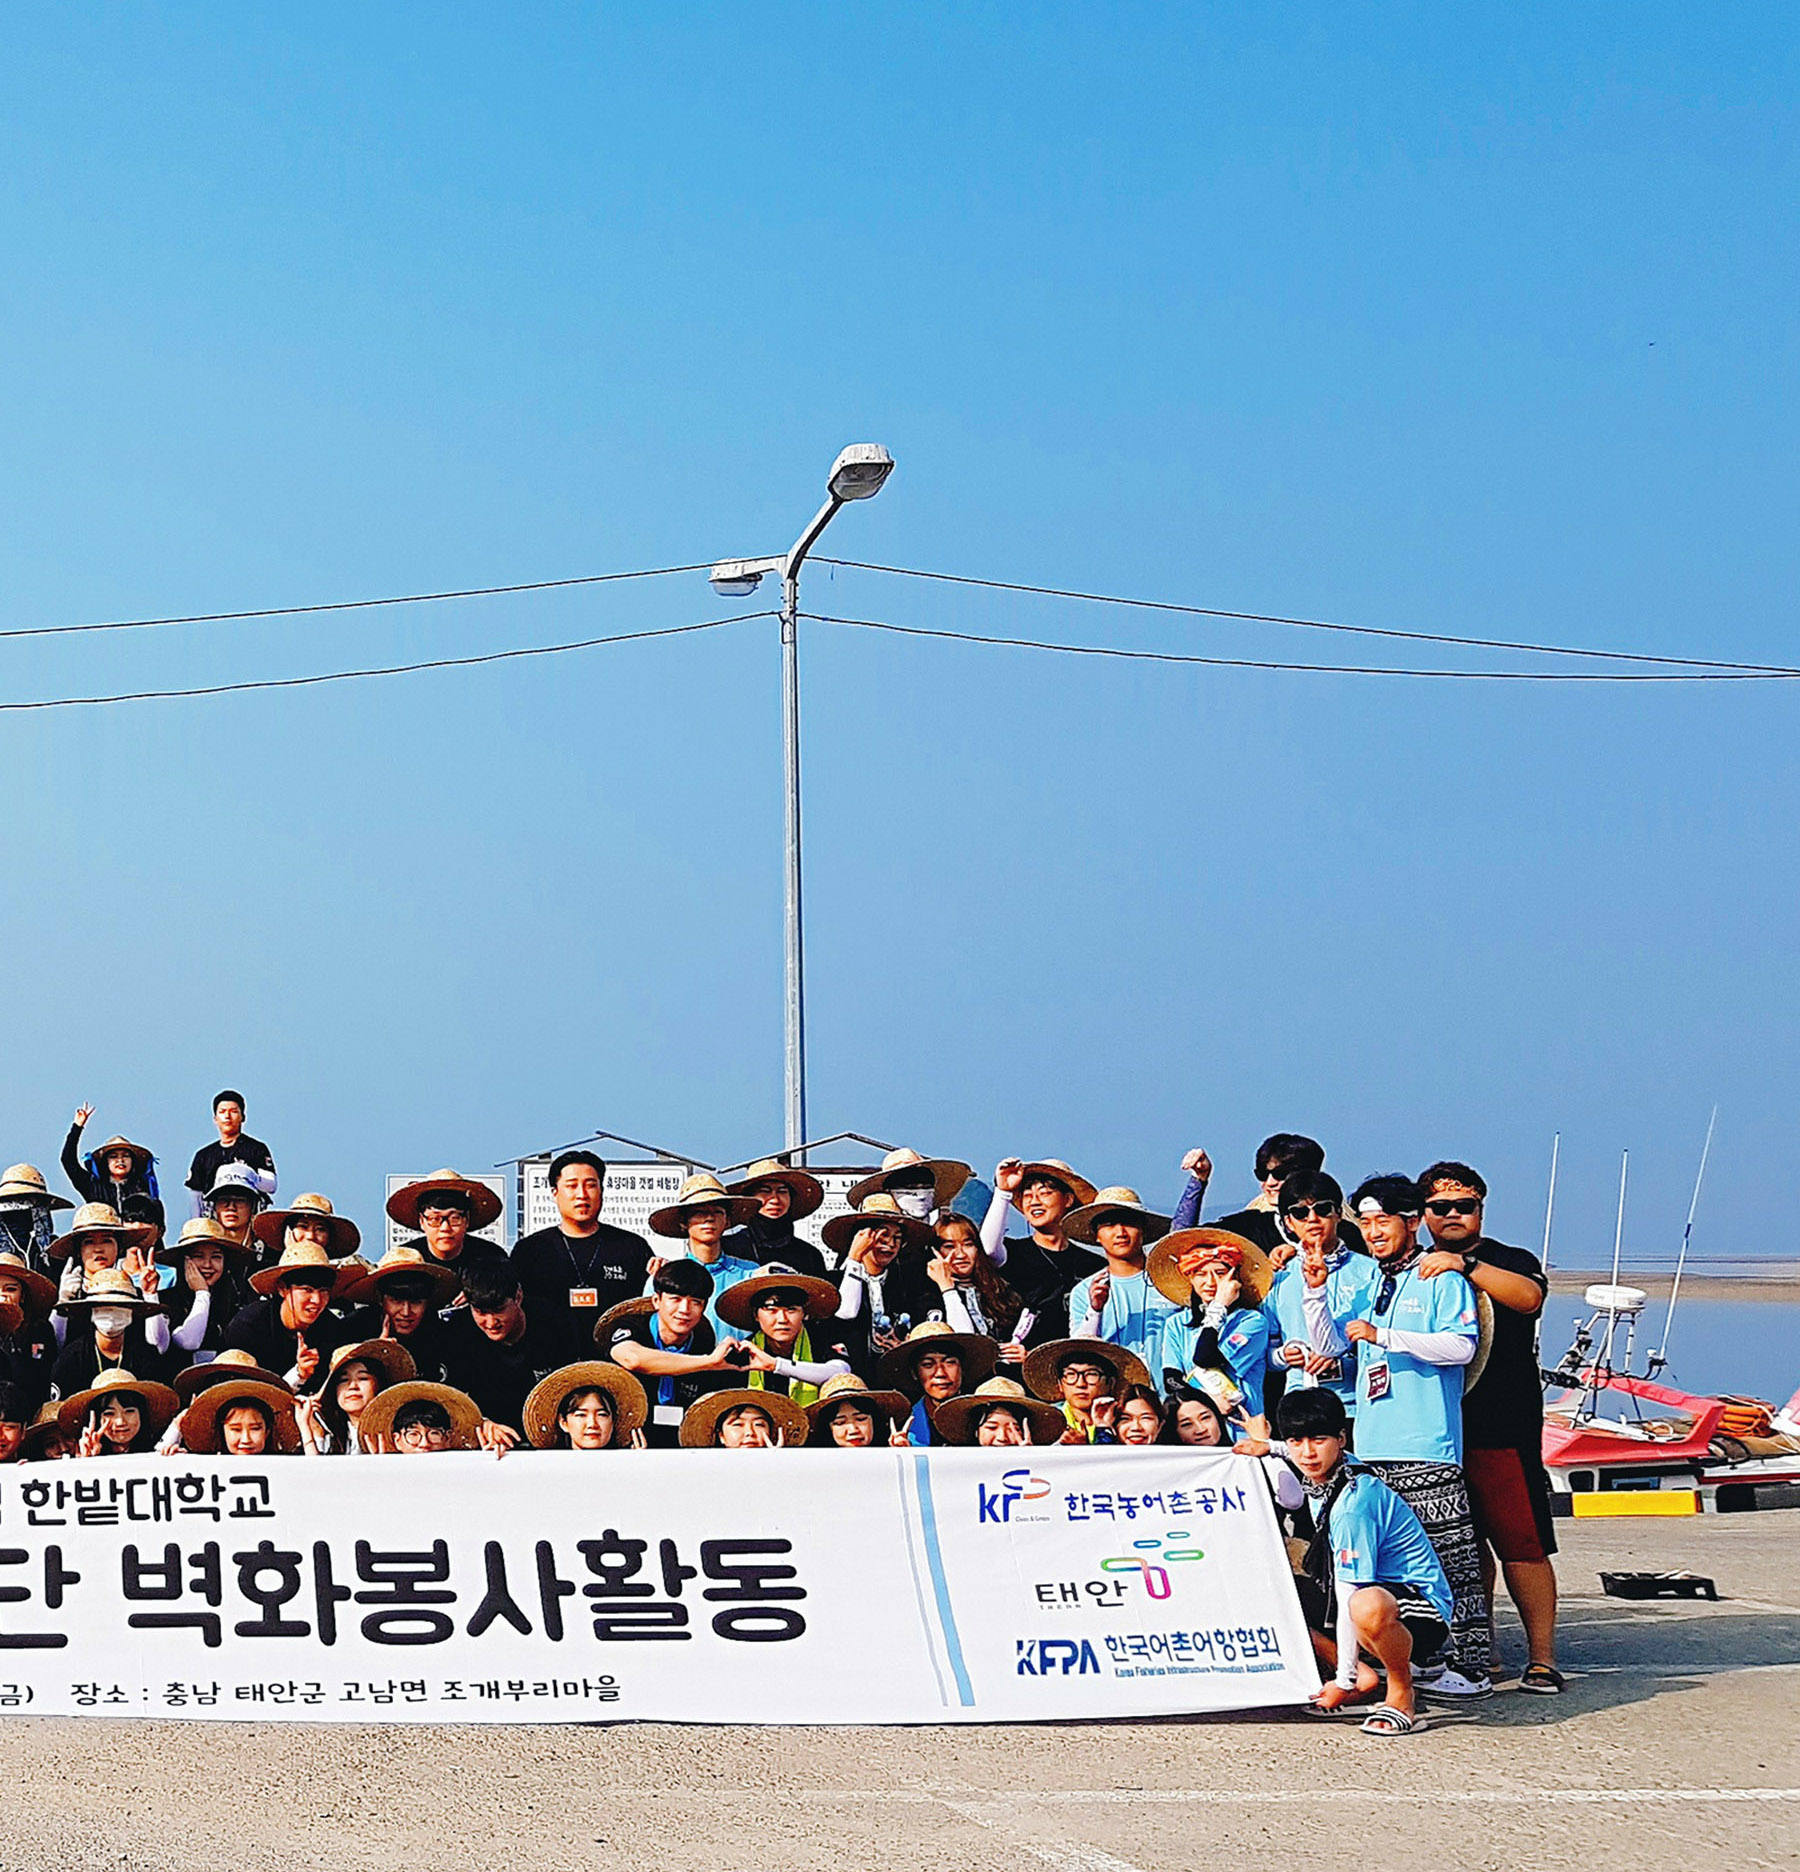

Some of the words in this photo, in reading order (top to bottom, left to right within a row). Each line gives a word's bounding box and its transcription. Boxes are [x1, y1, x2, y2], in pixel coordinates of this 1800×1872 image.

[19, 1474, 277, 1527] 한밭대학교
[1064, 1486, 1246, 1521] 한국농어촌공사
[122, 1529, 808, 1648] 벽화봉사활동
[1035, 1580, 1128, 1607] 태안
[1016, 1638, 1101, 1676] KFPA
[1104, 1626, 1281, 1663] 한국어촌어항협회
[69, 1683, 130, 1706] 장소
[162, 1682, 221, 1706] 충남
[235, 1682, 327, 1705] 태안군
[338, 1679, 427, 1704] 고남면
[439, 1675, 622, 1703] 조개부리마을
